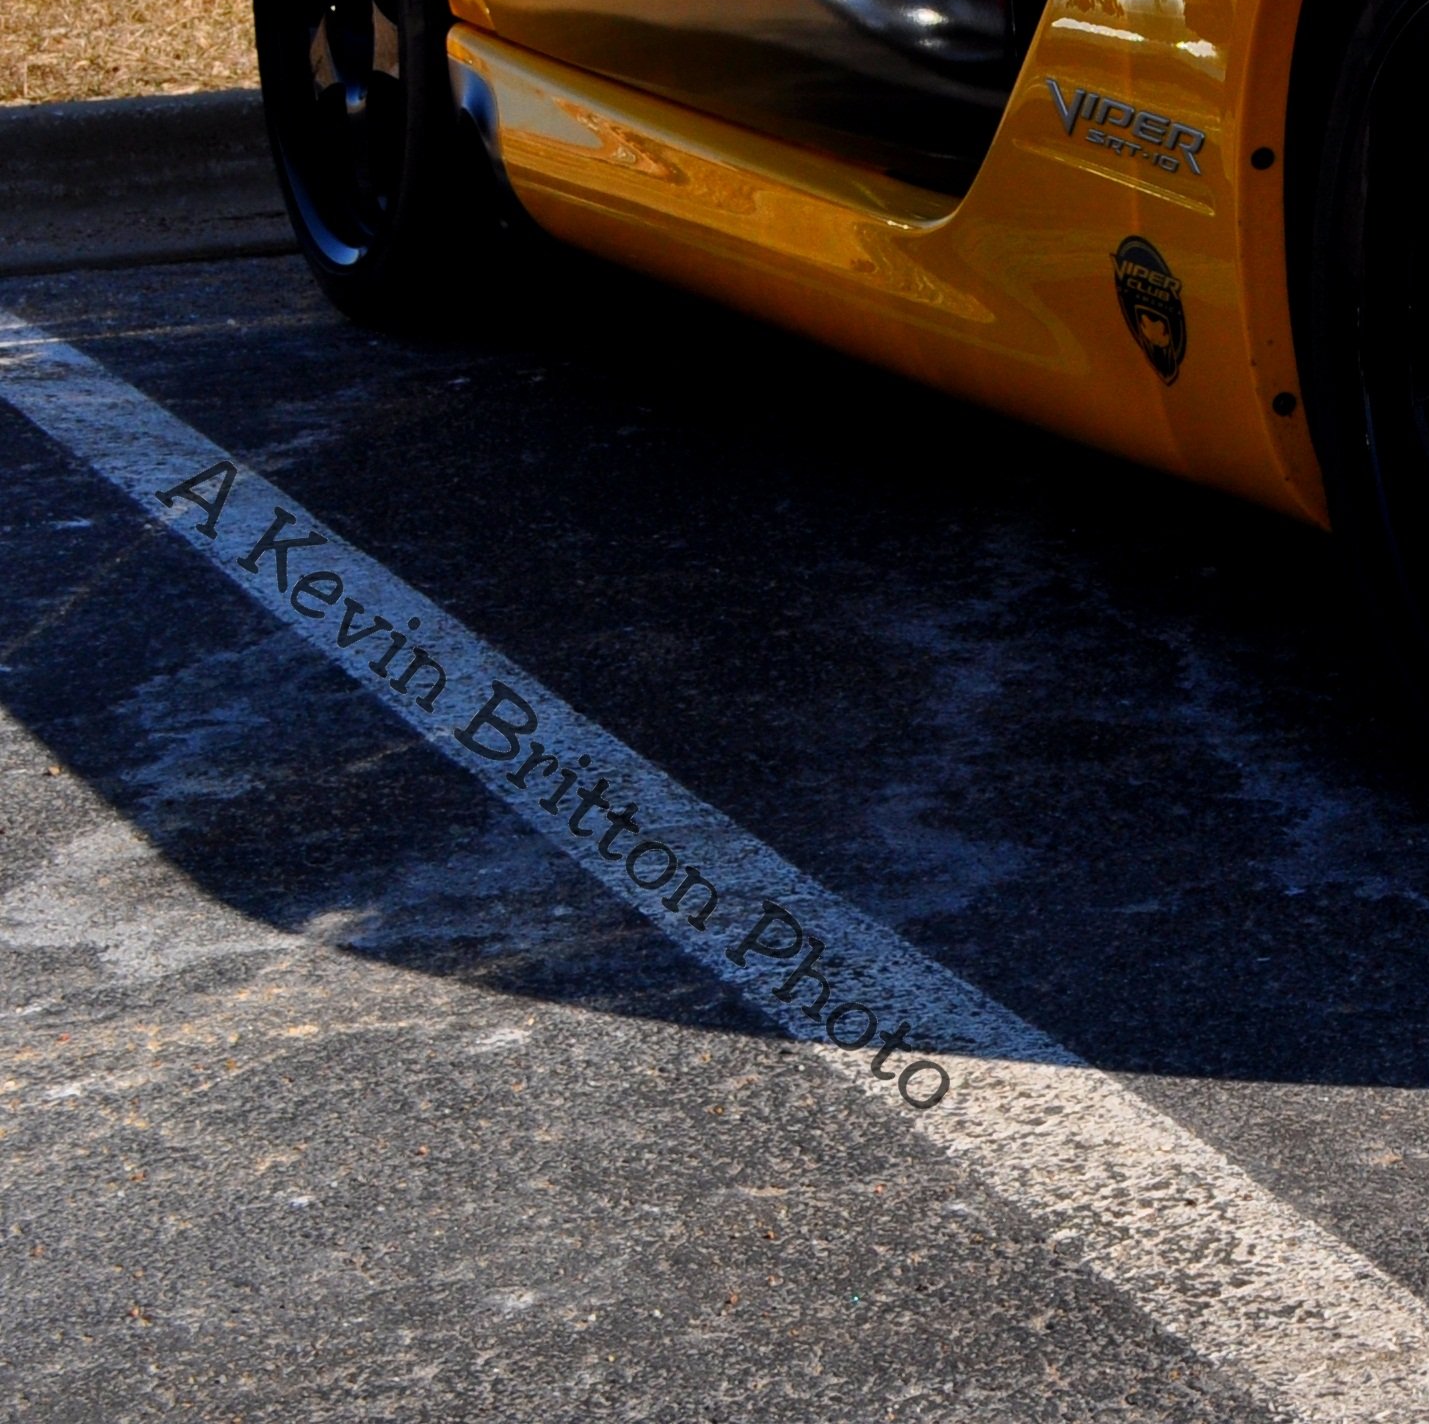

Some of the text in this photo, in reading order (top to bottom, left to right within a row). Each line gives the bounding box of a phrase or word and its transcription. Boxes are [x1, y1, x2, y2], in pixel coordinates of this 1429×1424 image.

[1045, 77, 1206, 176] VIPER
[1084, 129, 1180, 174] SRT-10
[1109, 252, 1182, 302] VIPER
[1126, 277, 1171, 302] CLUB
